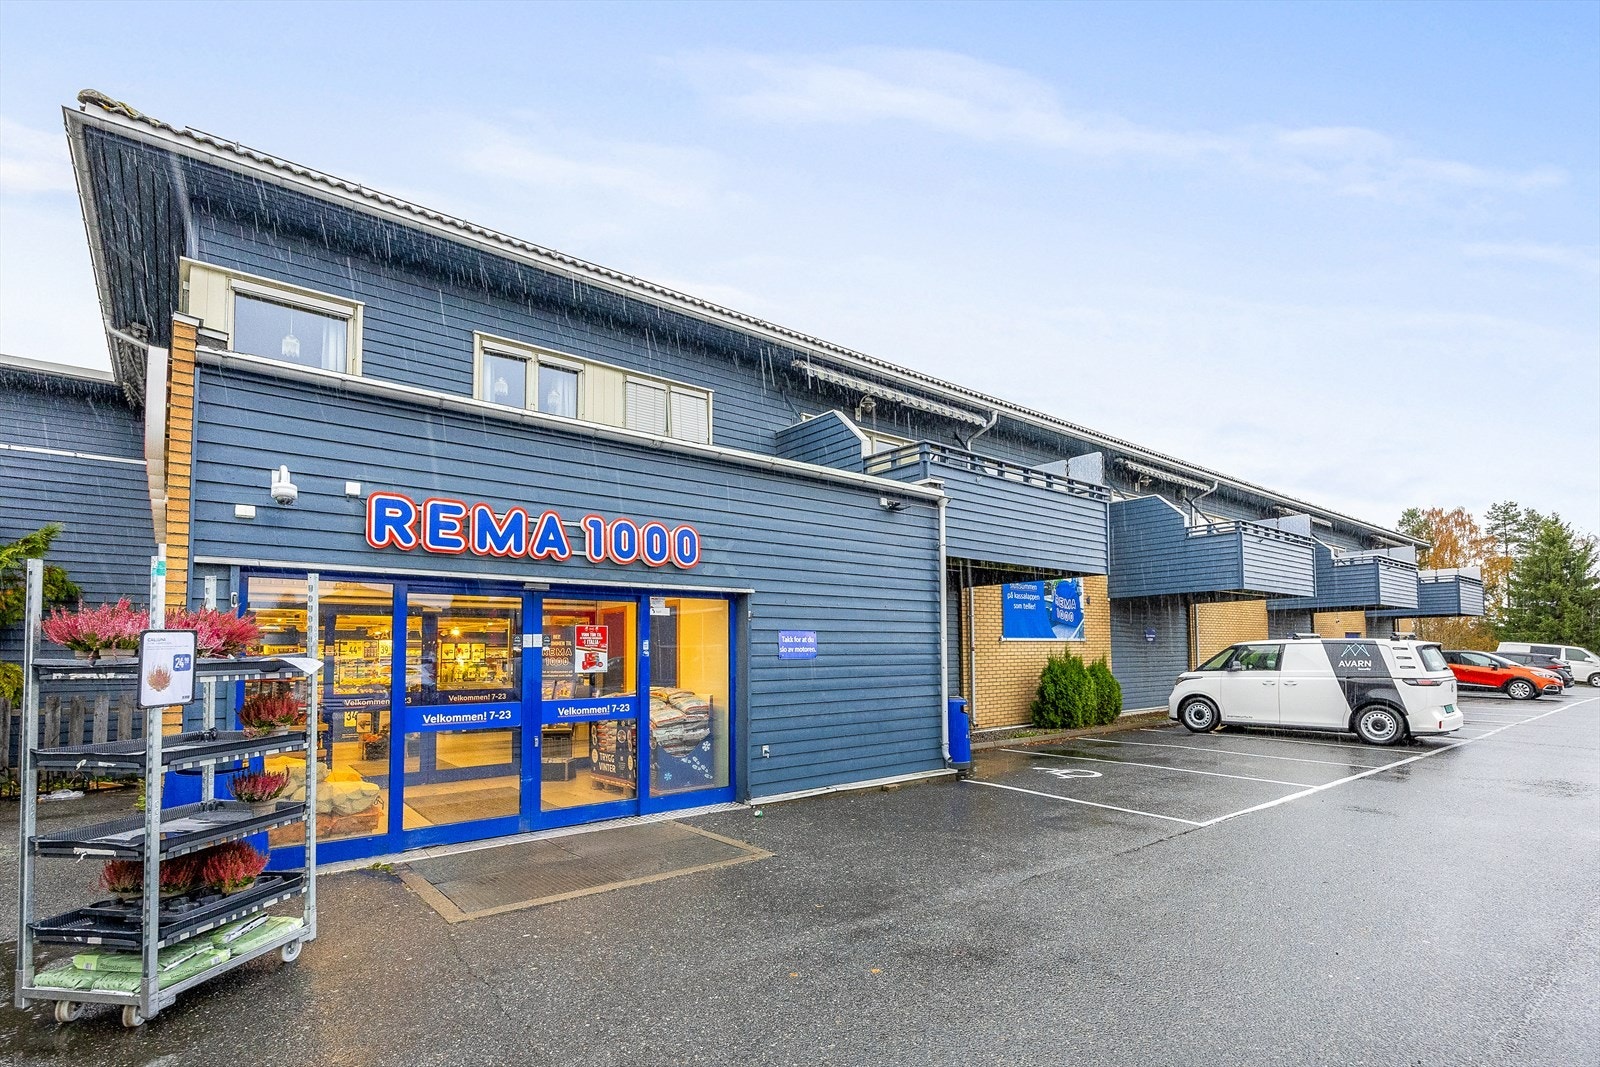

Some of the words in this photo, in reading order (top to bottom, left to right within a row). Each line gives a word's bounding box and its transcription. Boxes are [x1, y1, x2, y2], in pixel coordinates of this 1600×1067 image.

[366, 491, 572, 562] REMA
[580, 514, 701, 570] 1000
[1055, 593, 1076, 610] REMA
[1056, 607, 1074, 622] 1000
[542, 647, 572, 657] REMA
[175, 657, 185, 669] 24
[545, 657, 569, 667] 1000
[1338, 660, 1372, 668] AVARN
[449, 693, 490, 702] Velkommen!
[491, 692, 507, 700] 7-23
[557, 704, 610, 716] Velkommen!
[611, 703, 630, 713] 7-23
[422, 711, 487, 724] Velkommen!
[489, 710, 512, 720] 7-23
[599, 752, 615, 763] TRYGG
[598, 761, 616, 773] VINTER
